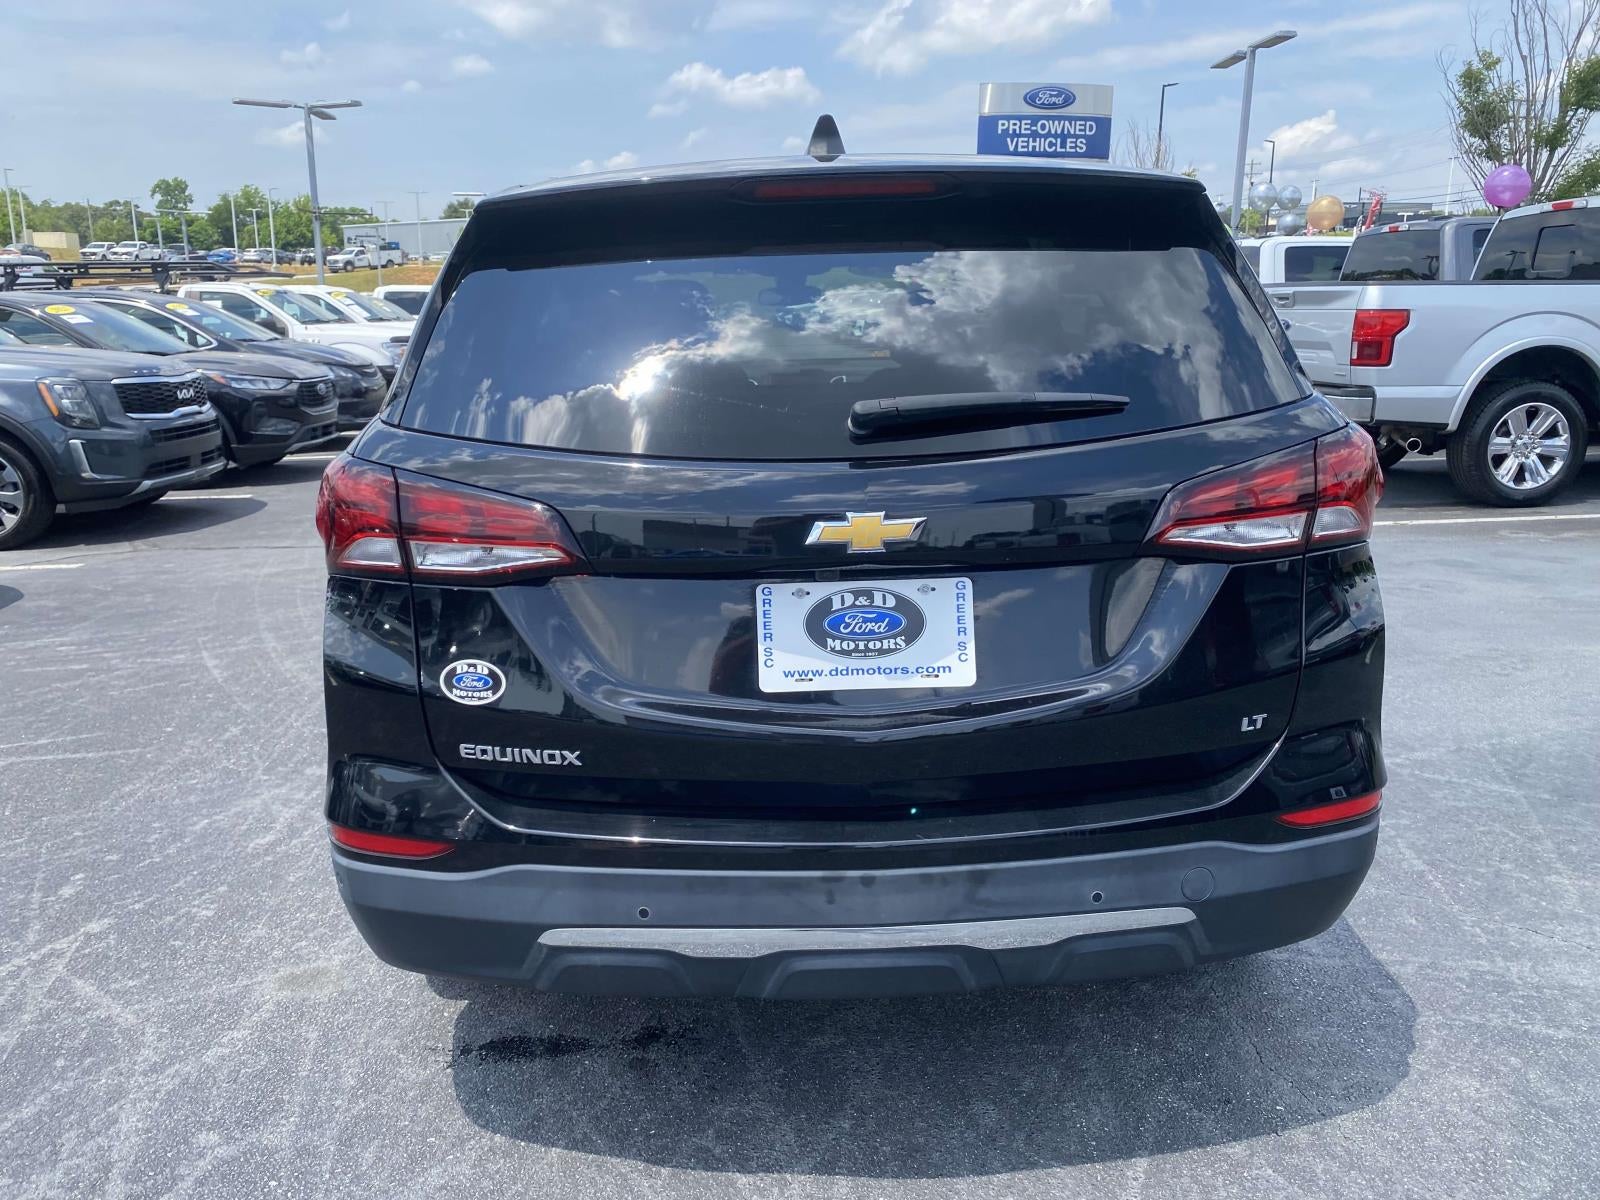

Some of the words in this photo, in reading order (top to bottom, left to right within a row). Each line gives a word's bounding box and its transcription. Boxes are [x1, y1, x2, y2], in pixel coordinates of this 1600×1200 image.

[1036, 90, 1065, 104] Ford
[997, 119, 1097, 136] PRE-OWNED
[1006, 137, 1087, 153] VEHICLES
[829, 590, 897, 611] D&D
[955, 580, 967, 636] GREER
[761, 586, 773, 642] GREER
[840, 612, 888, 634] Ford
[826, 635, 907, 651] MOTORS
[957, 641, 968, 662] SC
[763, 647, 774, 668] SC
[456, 664, 489, 675] D&D
[783, 664, 952, 678] www.ddmotors.com
[460, 675, 485, 687] Ford
[1240, 713, 1268, 732] LT
[459, 743, 582, 766] EQUINOX
